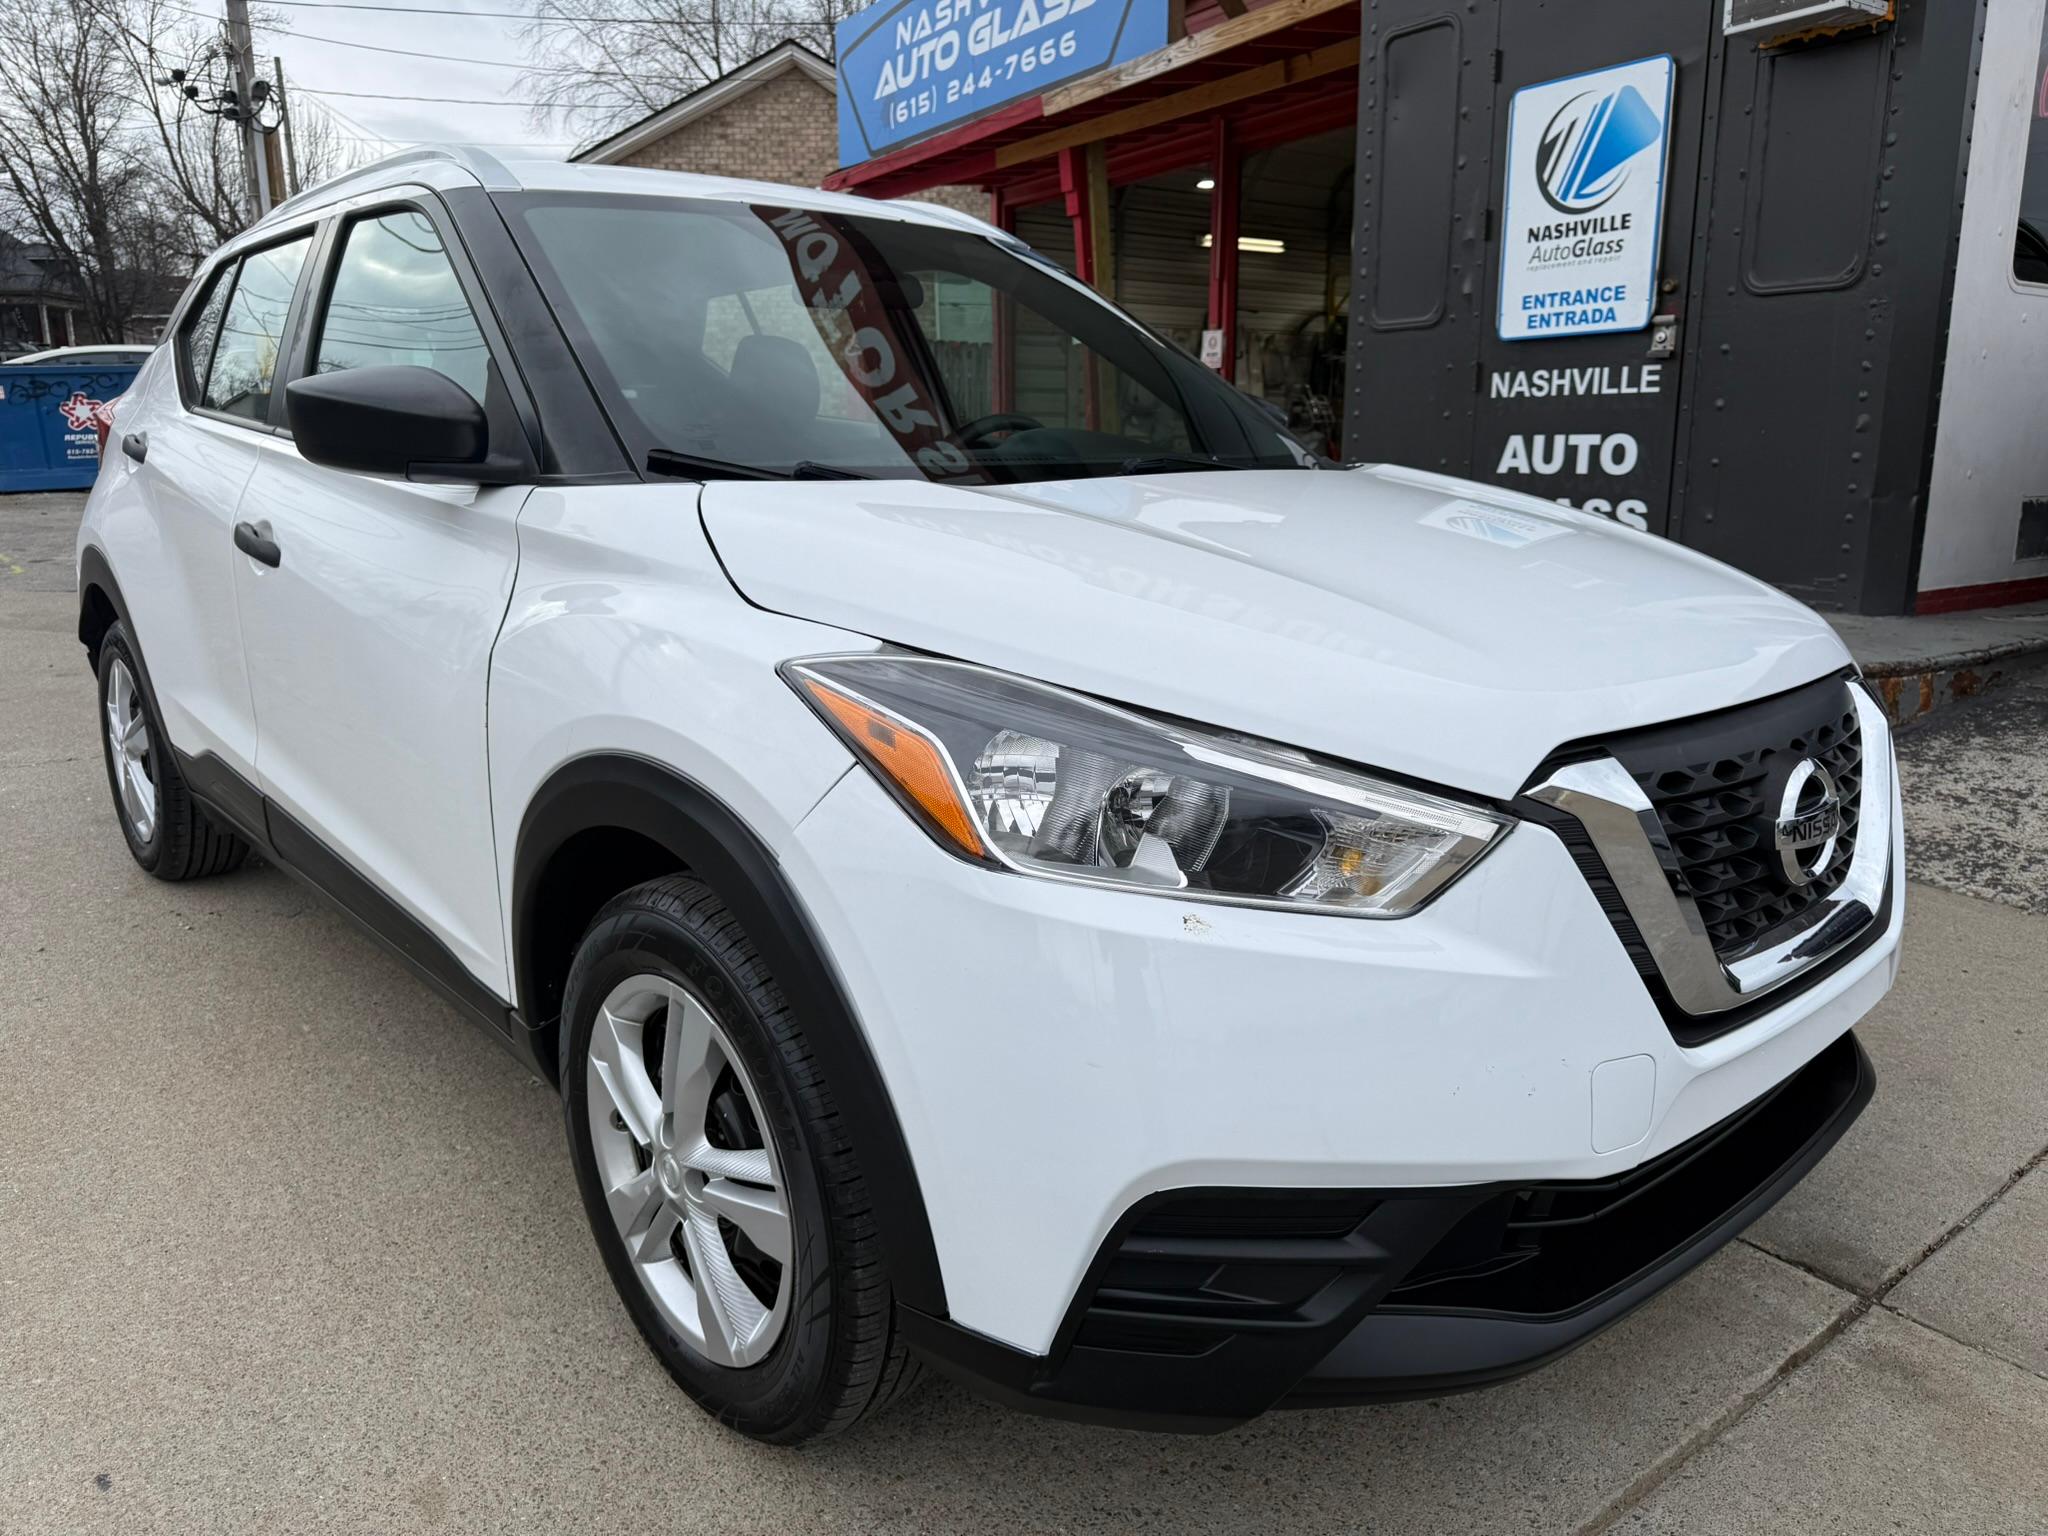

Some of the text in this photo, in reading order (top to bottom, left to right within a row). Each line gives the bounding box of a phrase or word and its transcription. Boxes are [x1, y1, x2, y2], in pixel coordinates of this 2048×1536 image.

[896, 0, 990, 50] NASH
[874, 30, 960, 100] AUTO
[889, 30, 1077, 130] (615) 244-7666
[1527, 213, 1632, 243] NASHVILLE
[1528, 237, 1624, 264] AutoGlass
[1521, 285, 1627, 310] ENTRANCE
[1527, 306, 1617, 329] ENTRADA
[1490, 364, 1662, 399] NASHVILLE
[1496, 433, 1638, 476] AUTO
